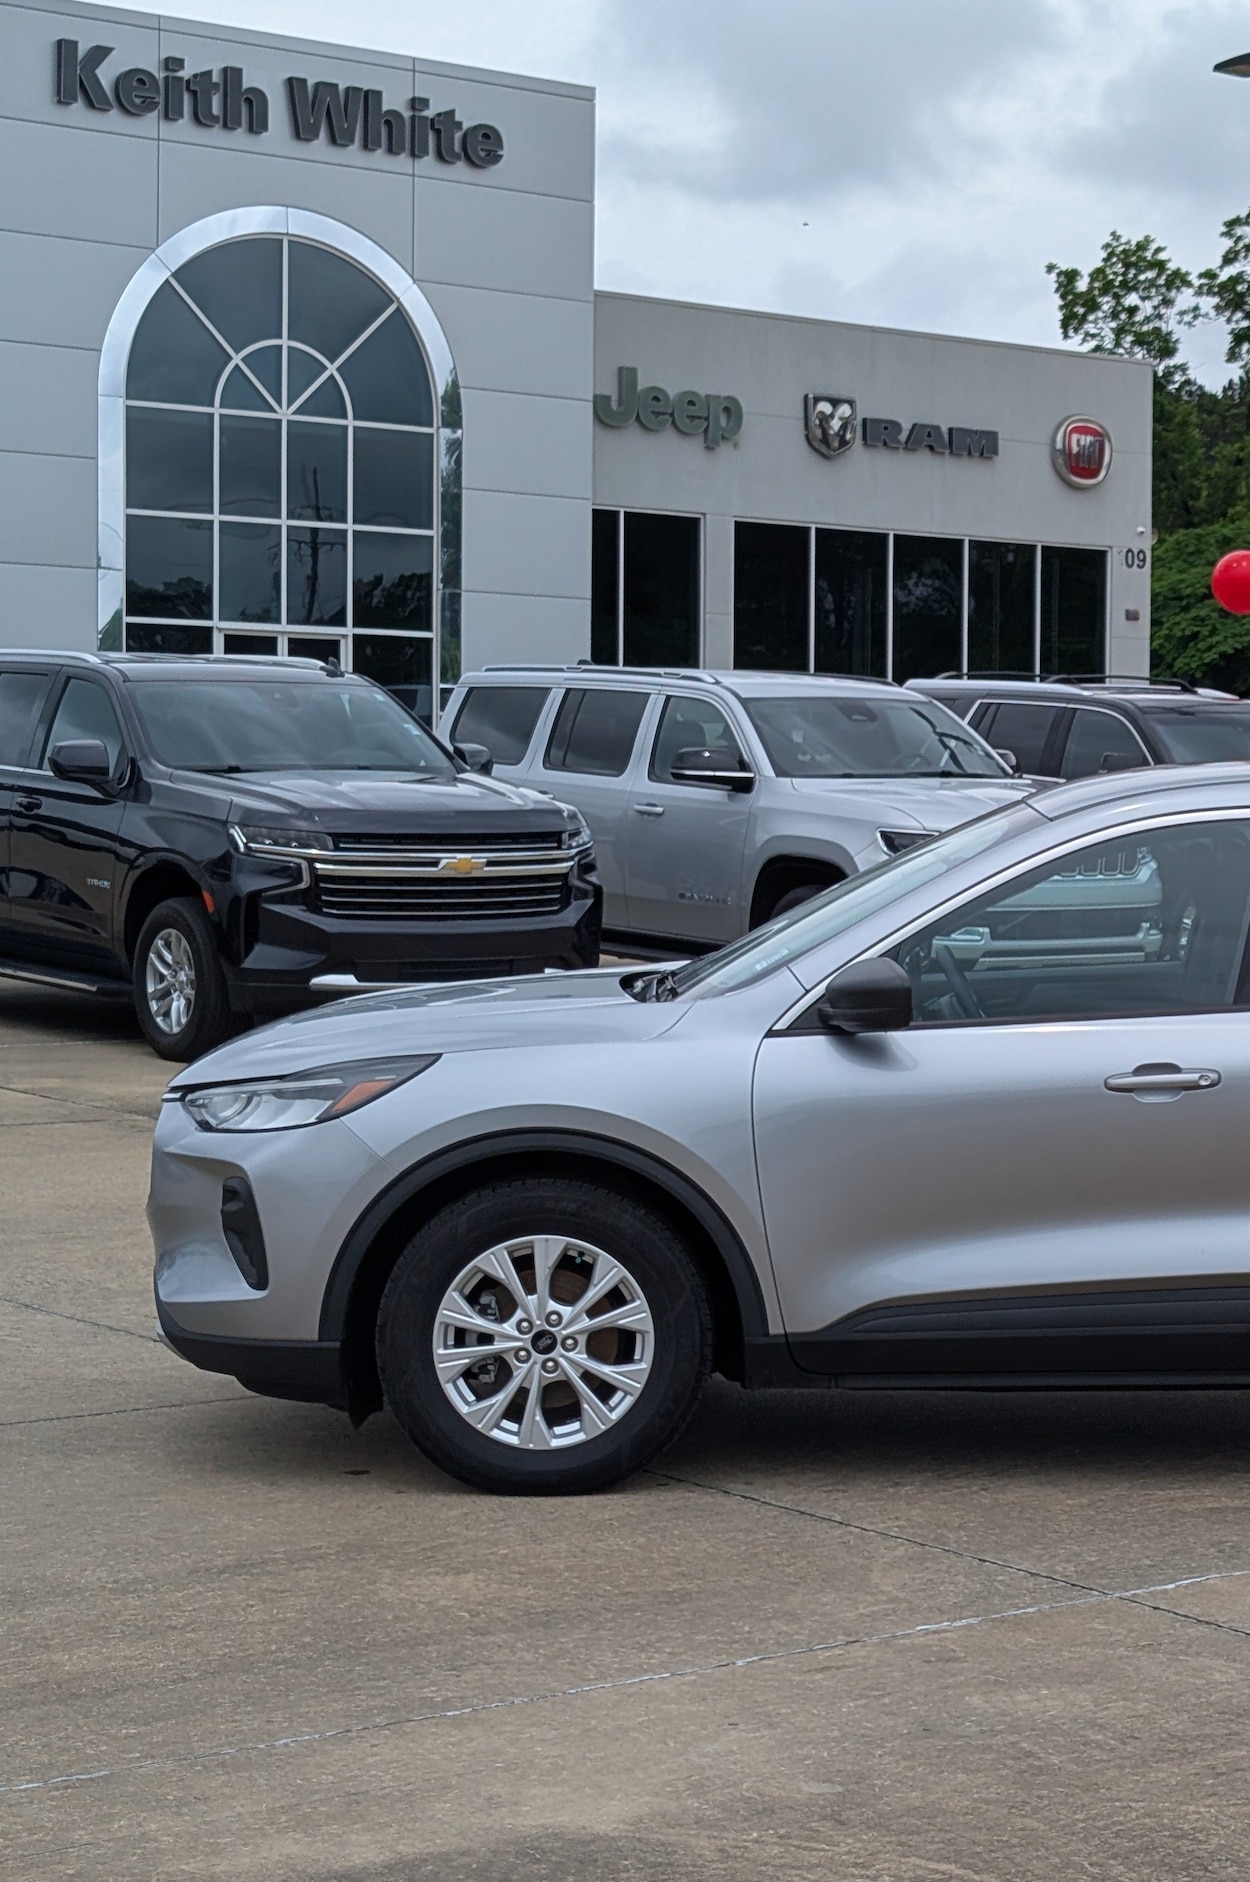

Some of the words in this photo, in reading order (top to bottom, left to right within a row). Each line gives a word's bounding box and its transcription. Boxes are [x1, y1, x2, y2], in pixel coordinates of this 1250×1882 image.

[56, 38, 269, 134] Keith
[286, 76, 505, 169] White
[593, 366, 744, 450] Jeep
[862, 417, 999, 459] RAM
